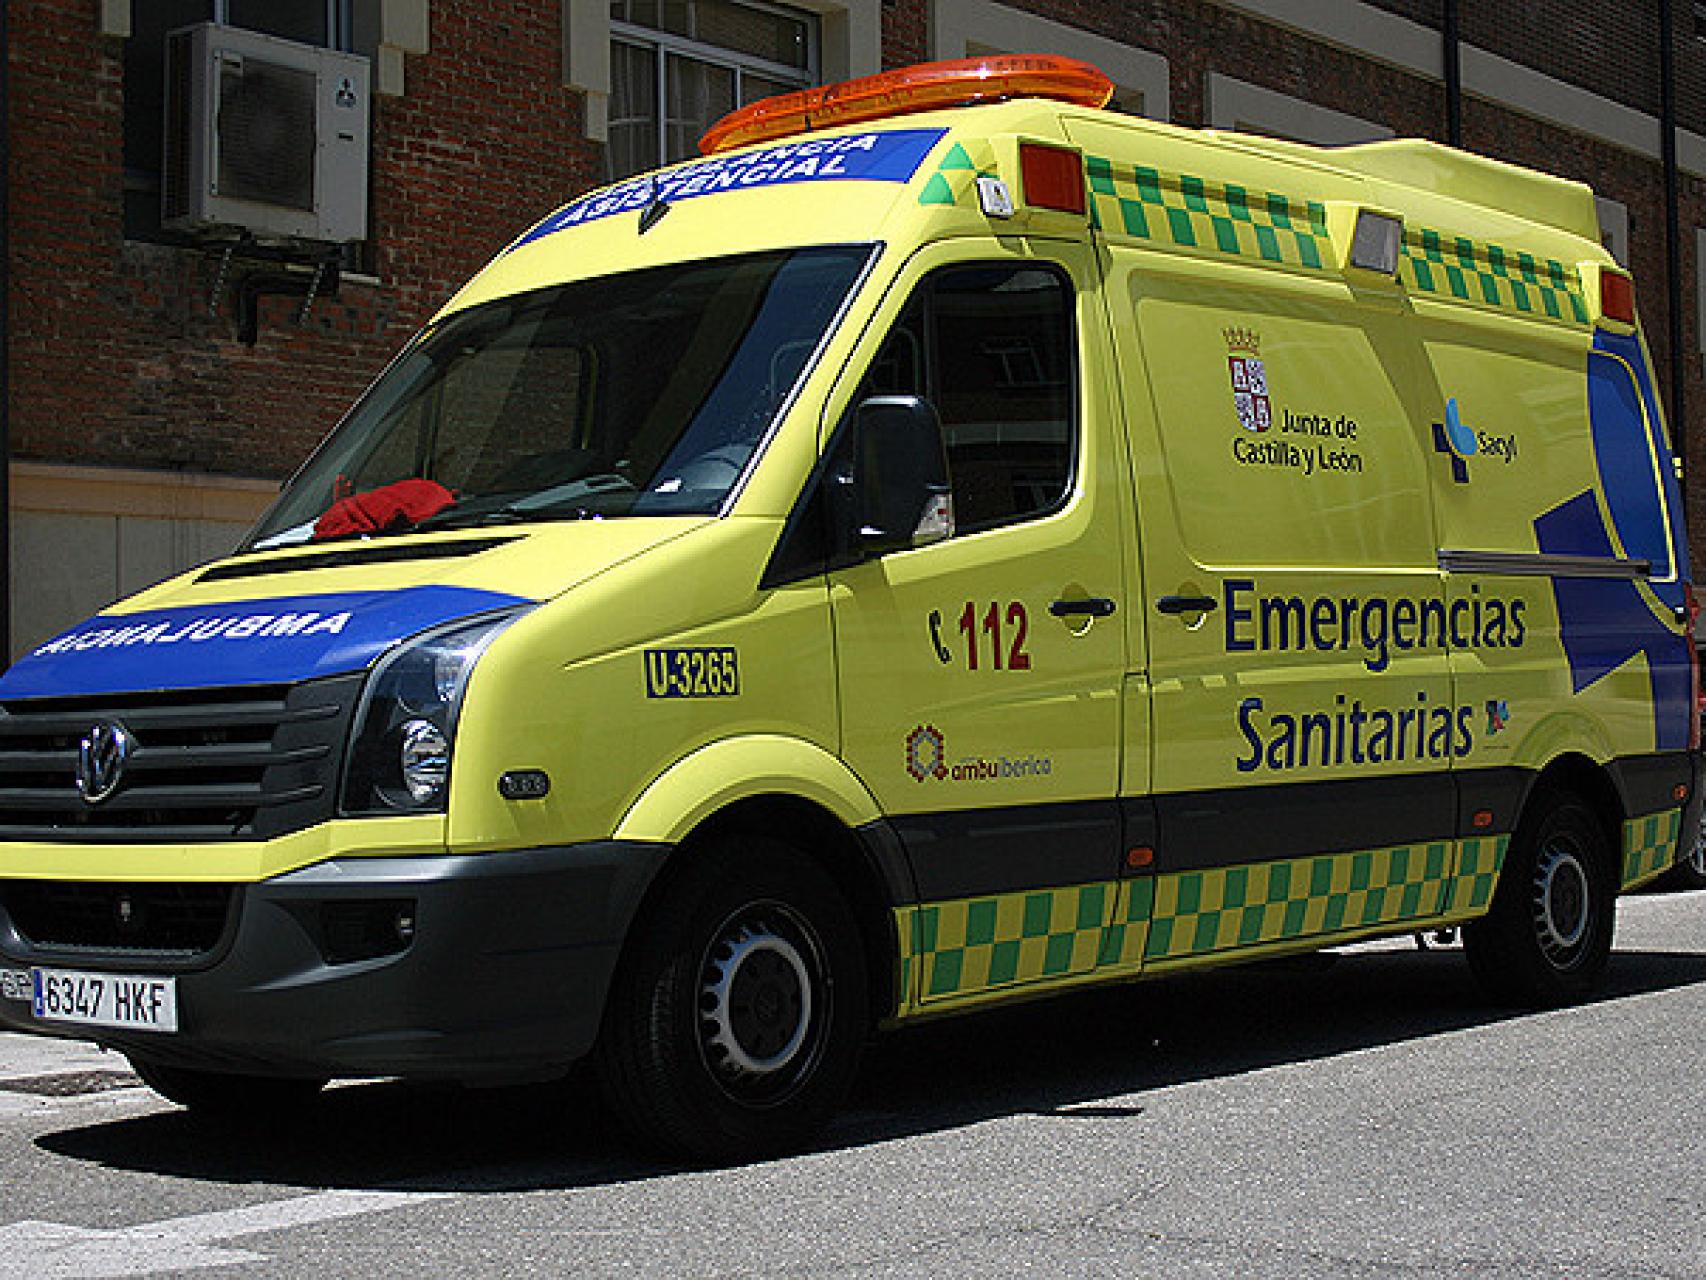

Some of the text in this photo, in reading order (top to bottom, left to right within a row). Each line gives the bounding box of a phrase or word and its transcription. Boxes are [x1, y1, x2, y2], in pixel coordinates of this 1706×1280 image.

[1281, 409, 1357, 440] Junta de
[1477, 431, 1517, 464] Sacyl
[1233, 437, 1363, 475] Castilla y León
[959, 601, 1032, 670] 112
[1222, 579, 1526, 672] Emergencias
[649, 651, 736, 696] U-3265
[1236, 691, 1474, 772] Sanitarias
[47, 976, 165, 1023] 6347 HKF
